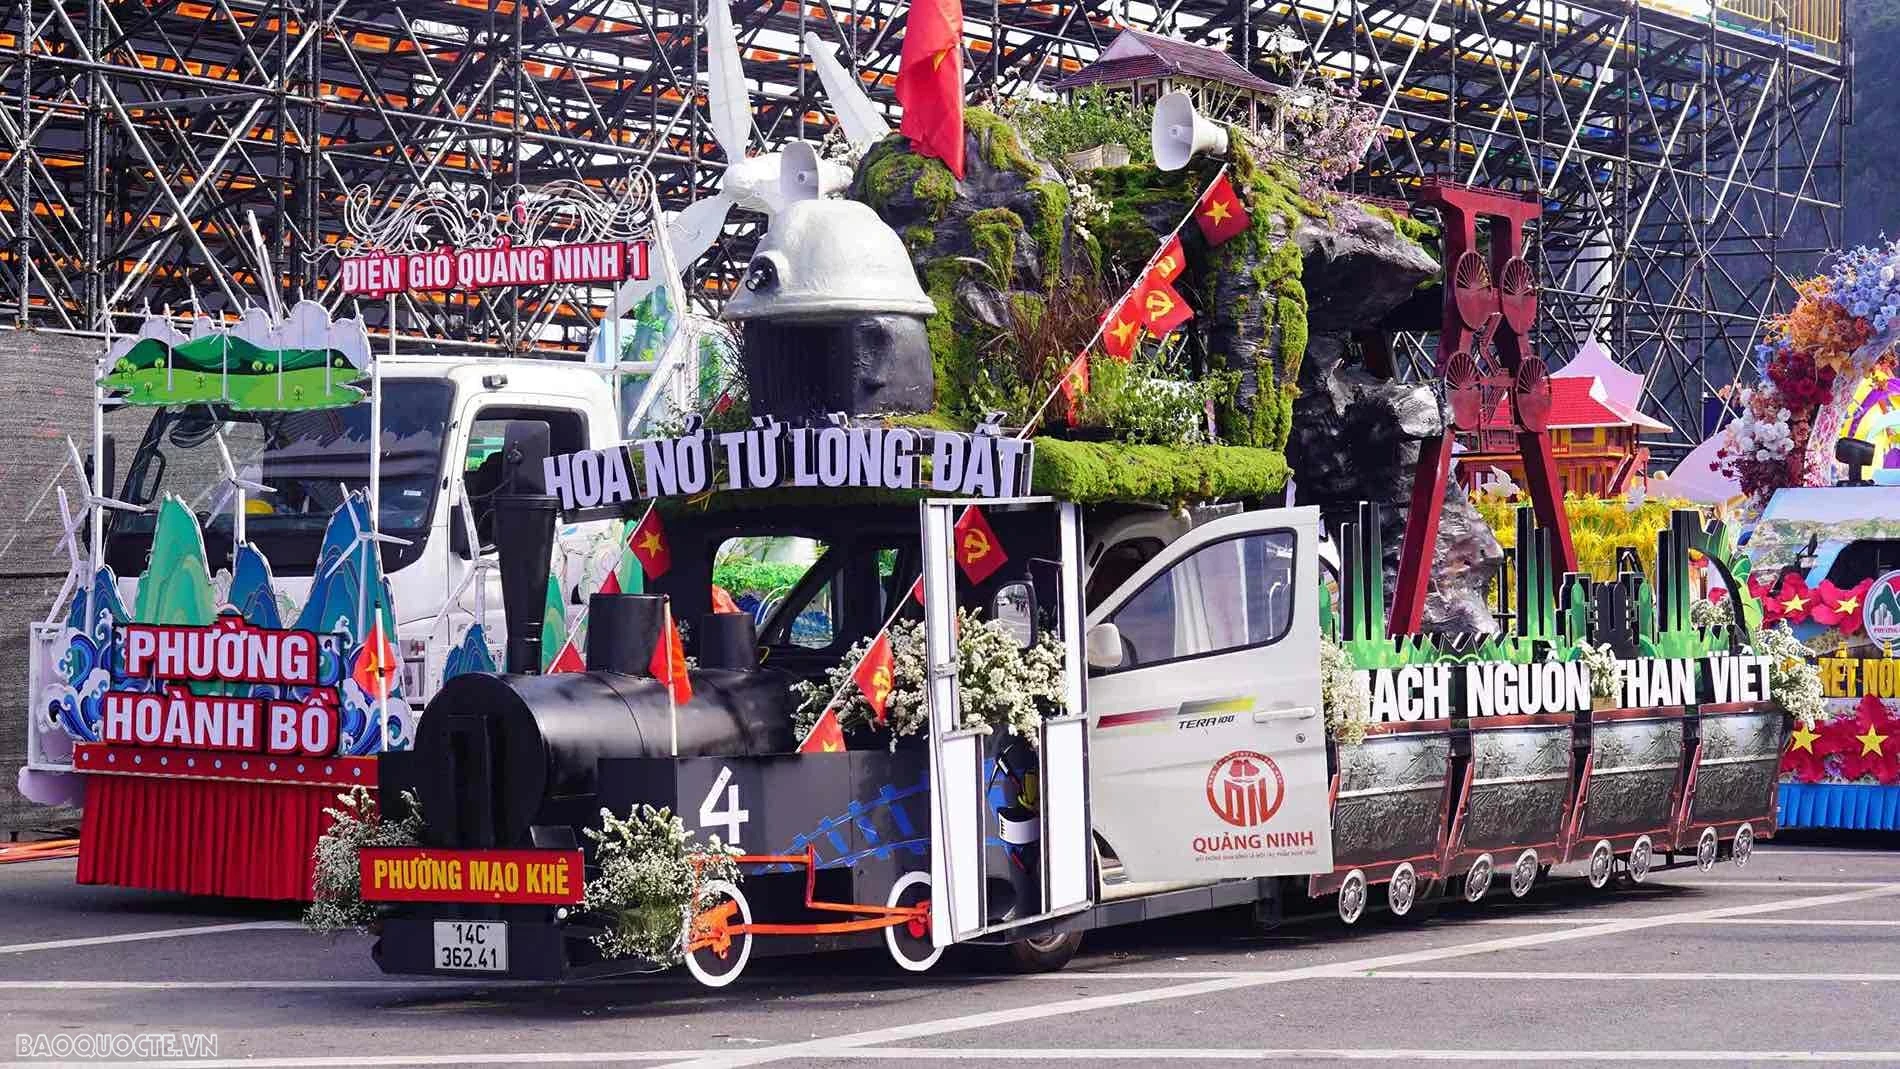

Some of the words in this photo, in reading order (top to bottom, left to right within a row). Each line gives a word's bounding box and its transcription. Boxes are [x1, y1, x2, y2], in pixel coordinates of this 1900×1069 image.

[343, 250, 398, 296] ĐIỆN
[409, 247, 450, 287] GIÓ
[459, 239, 545, 285] QUẢNG
[554, 244, 618, 280] NINH
[628, 245, 640, 276] 1
[543, 445, 632, 510] HOA
[643, 413, 706, 498] NỞ
[720, 413, 782, 489] TỪ
[794, 411, 914, 490] LÒNG
[932, 411, 1024, 498] ĐẤT
[129, 621, 308, 680] PHƯỜNG
[107, 690, 254, 748] HOÀNH
[271, 692, 329, 752] BỒ
[1179, 717, 1216, 729] TERA
[1217, 715, 1235, 723] 100
[700, 766, 749, 844] 4
[1266, 832, 1313, 848] NINH
[374, 853, 462, 890] PHƯỜNG
[470, 861, 519, 898] MẠO
[527, 858, 569, 894] KHÊ
[442, 948, 497, 968] 362.41
[455, 924, 486, 945] 14C
